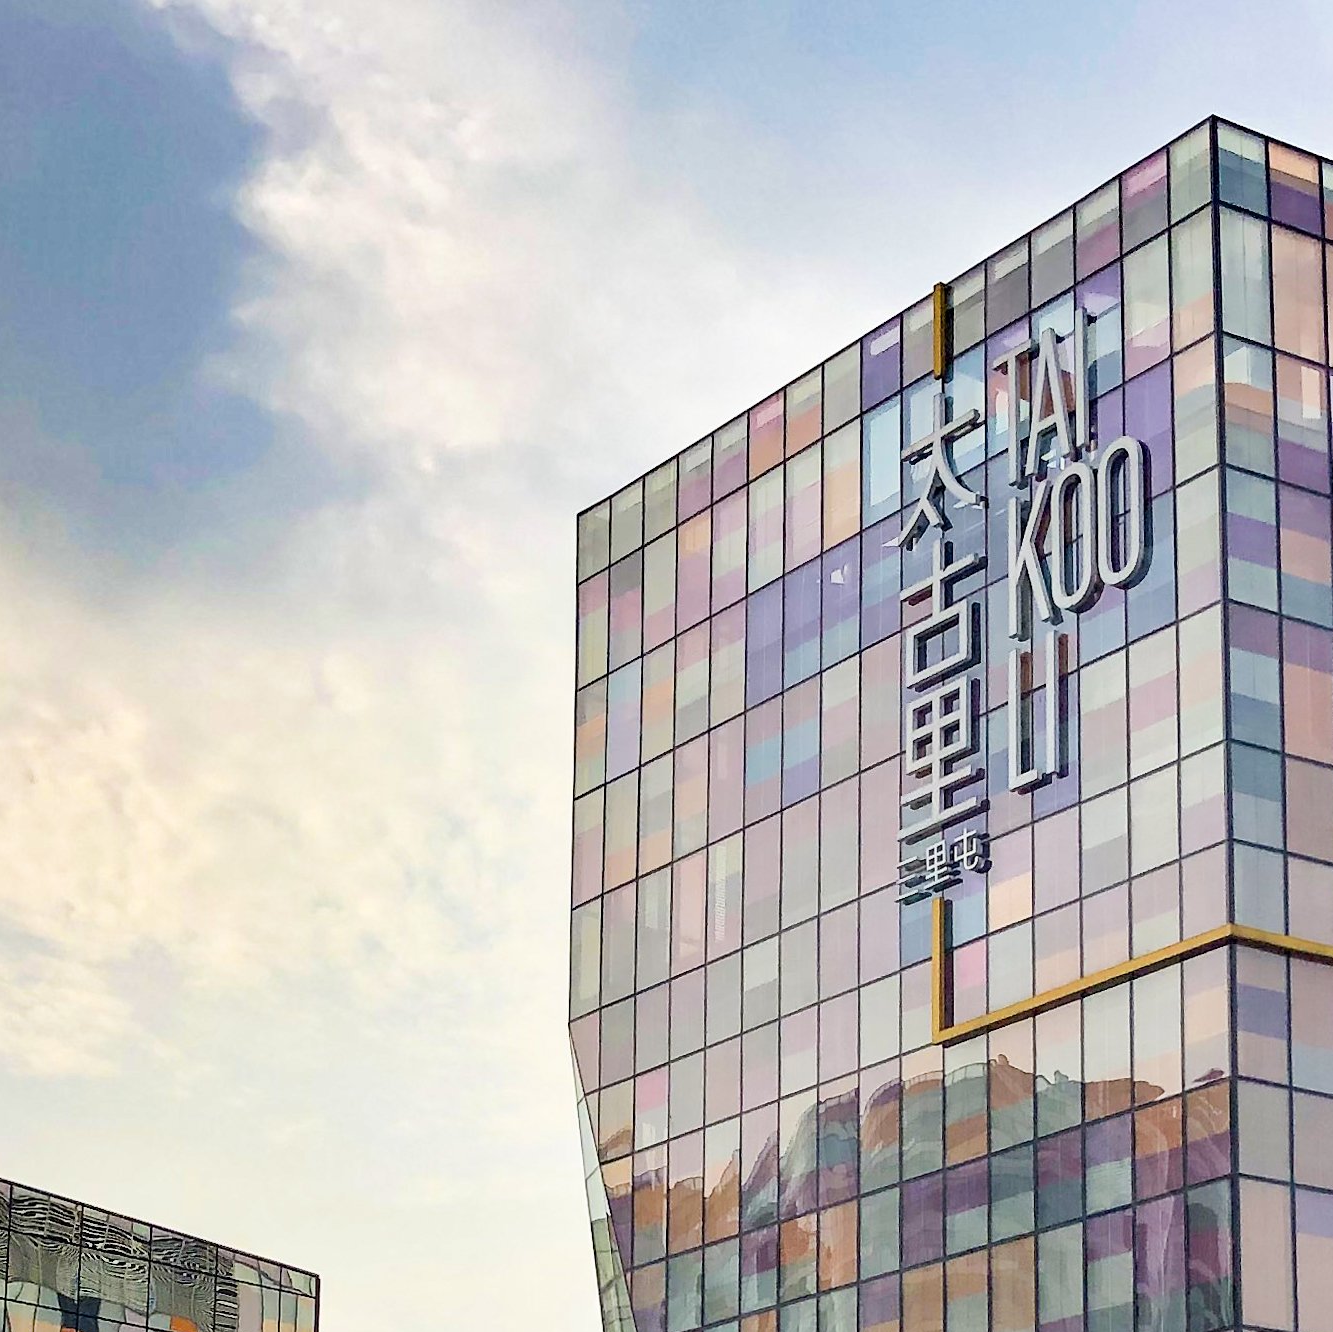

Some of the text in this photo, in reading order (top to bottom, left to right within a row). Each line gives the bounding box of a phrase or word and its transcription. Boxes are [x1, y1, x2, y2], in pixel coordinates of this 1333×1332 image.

[992, 307, 1094, 486] TAI
[899, 393, 984, 843] 太古里
[1008, 436, 1150, 640] KOO
[1008, 631, 1068, 792] LI
[896, 828, 980, 903] 三里屯
